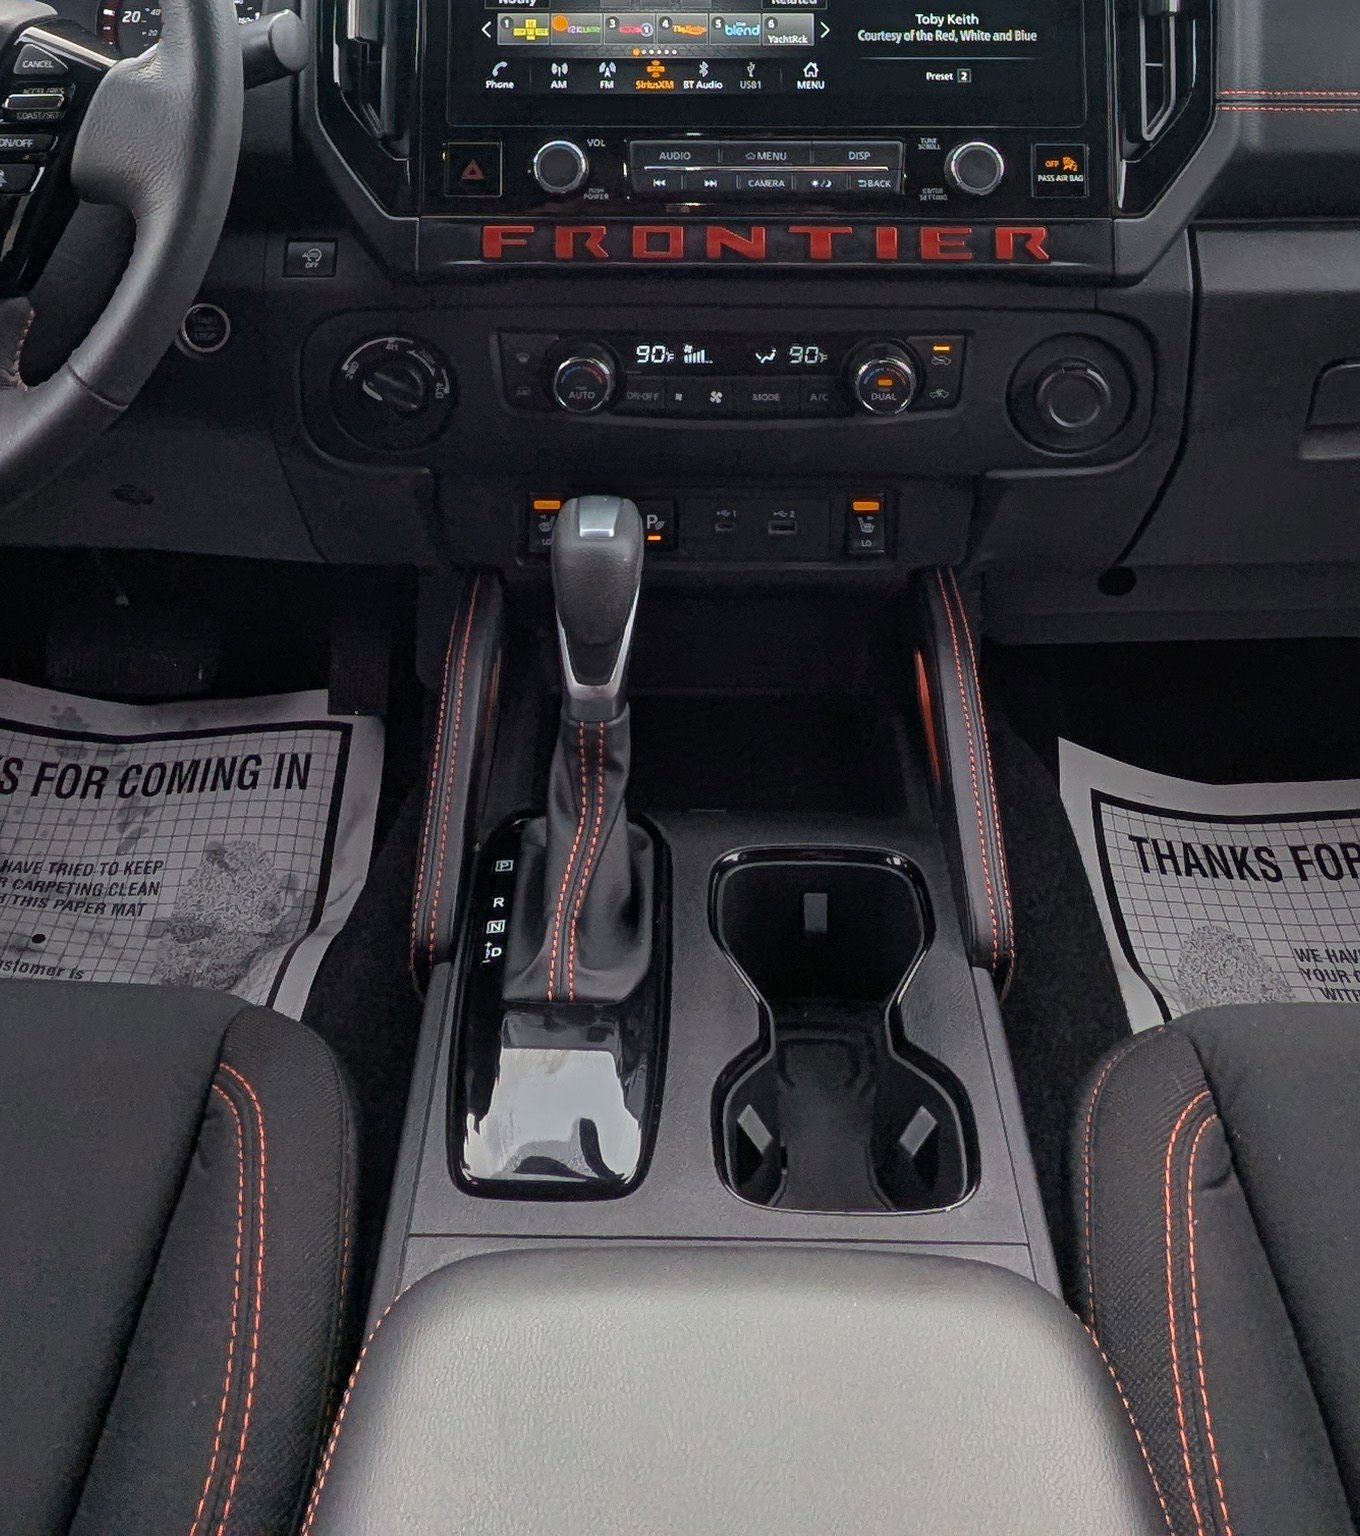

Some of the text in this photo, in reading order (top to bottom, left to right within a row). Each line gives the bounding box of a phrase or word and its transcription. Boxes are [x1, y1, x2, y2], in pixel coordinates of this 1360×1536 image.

[122, 11, 141, 23] 20
[915, 14, 979, 26] Toby Keith
[609, 19, 616, 28] 3
[661, 19, 669, 28] 4
[715, 19, 722, 28] 5
[768, 19, 774, 28] 6
[725, 23, 761, 36] blend
[768, 35, 808, 44] YachtRck
[857, 30, 1038, 44] Courtesy of the Red, White and Blue
[22, 60, 54, 68] CANCEL
[926, 71, 968, 81] Preset 2
[485, 80, 514, 89] Phone
[550, 80, 567, 89] AM
[600, 80, 614, 89] FM
[635, 80, 674, 89] SiriusXM
[683, 80, 723, 89] BT Audio
[740, 80, 762, 89] USB1
[797, 80, 825, 89] MENU
[587, 139, 606, 148] VOL
[659, 151, 691, 161] AUDIO
[757, 151, 787, 161] MENU
[848, 151, 871, 161] DISP
[748, 179, 785, 188] CAMERA
[867, 179, 891, 188] BACK
[482, 224, 1051, 262] FRONTIER
[568, 391, 596, 400] AUTO
[752, 392, 781, 401] MODE
[810, 392, 829, 401] A/C
[871, 391, 897, 401] DUAL
[647, 515, 658, 529] P
[860, 539, 872, 547] LO
[31, 761, 109, 800] FOR
[117, 754, 262, 799] COMING
[273, 752, 312, 790] IN
[1129, 834, 1283, 882] THANKS
[0, 859, 40, 874] HAVE
[48, 862, 93, 877] TRIED
[100, 861, 119, 875] TO
[123, 860, 164, 875] KEEP
[12, 878, 104, 896] CARPETING
[108, 881, 160, 897] CLEAN
[11, 894, 49, 909] THIS
[53, 899, 106, 915] PAPER
[111, 902, 147, 917] MAT
[493, 897, 505, 907] R
[489, 921, 503, 931] N
[491, 947, 502, 957] D
[1294, 948, 1323, 963] WE
[1299, 967, 1351, 984] YOUR
